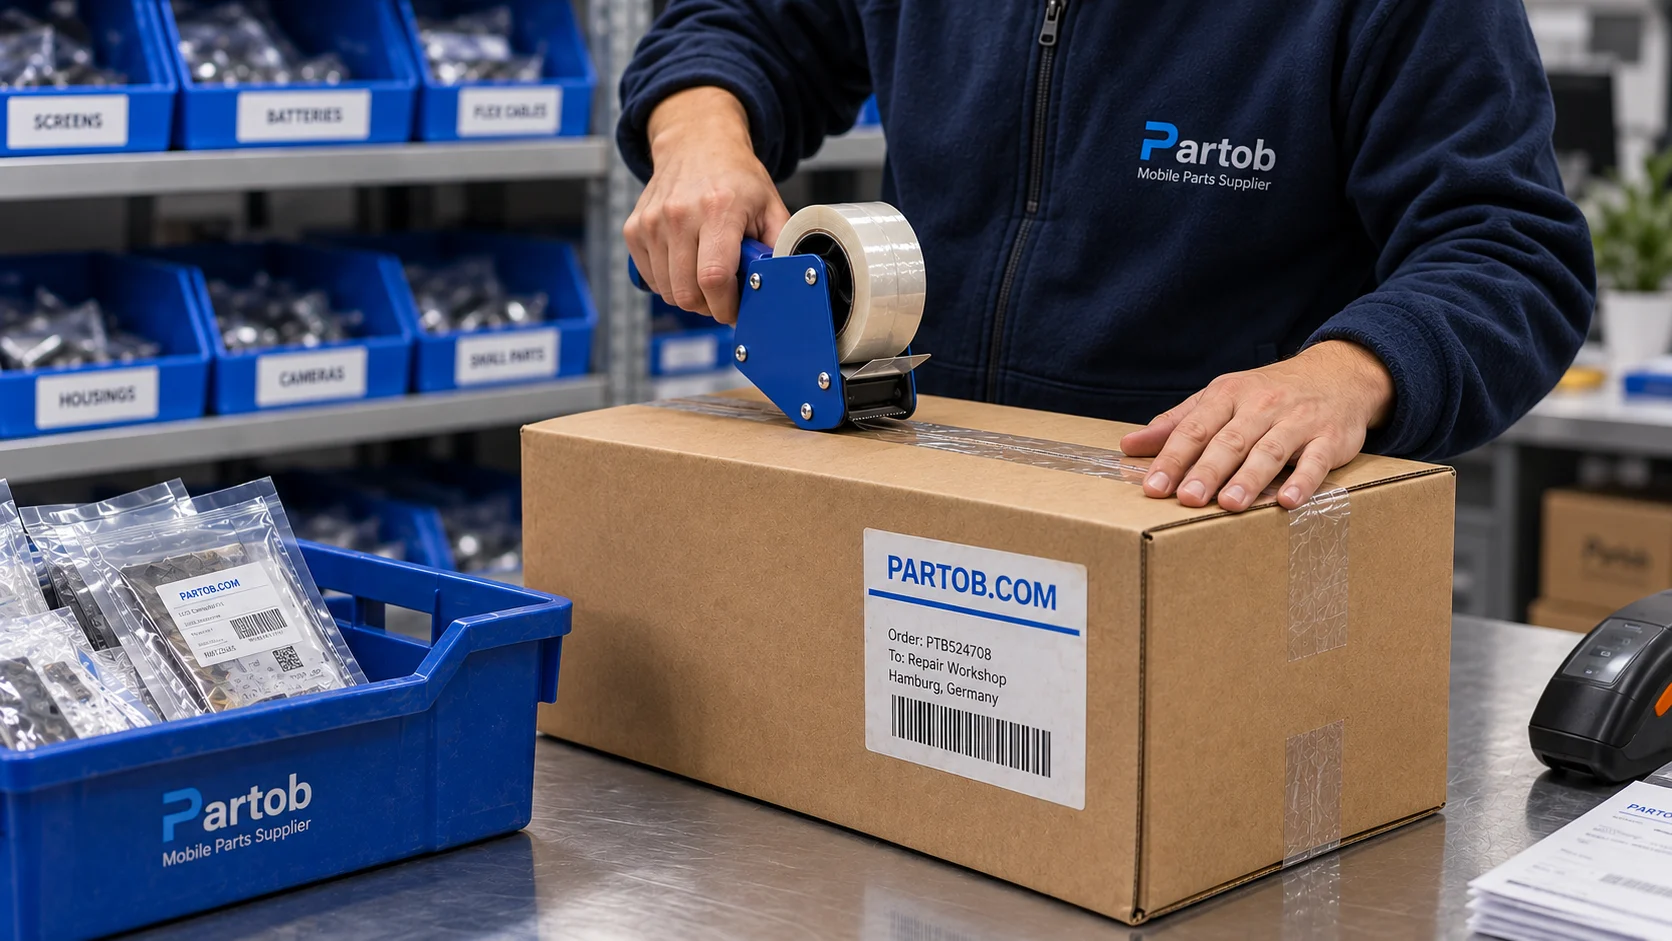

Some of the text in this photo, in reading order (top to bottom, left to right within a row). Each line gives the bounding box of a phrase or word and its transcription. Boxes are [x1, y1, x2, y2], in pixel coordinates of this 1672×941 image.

[34, 112, 103, 131] SCREENS
[267, 107, 342, 125] BATTERIES
[1140, 120, 1276, 172] Partob
[1137, 167, 1272, 191] Mobile Parts Supplier
[279, 366, 344, 387] CAMERAS
[59, 387, 135, 408] HOUSINGS
[179, 579, 240, 601] PARTOB.COM
[887, 554, 1057, 611] PARTOB.COM
[888, 628, 992, 661] Order: PTB524708
[888, 649, 1007, 688] To: Repair Workshop
[889, 669, 999, 707] Hamburg, Germany
[163, 773, 312, 843] Partob
[162, 818, 312, 867] Mobile Parts Supplier
